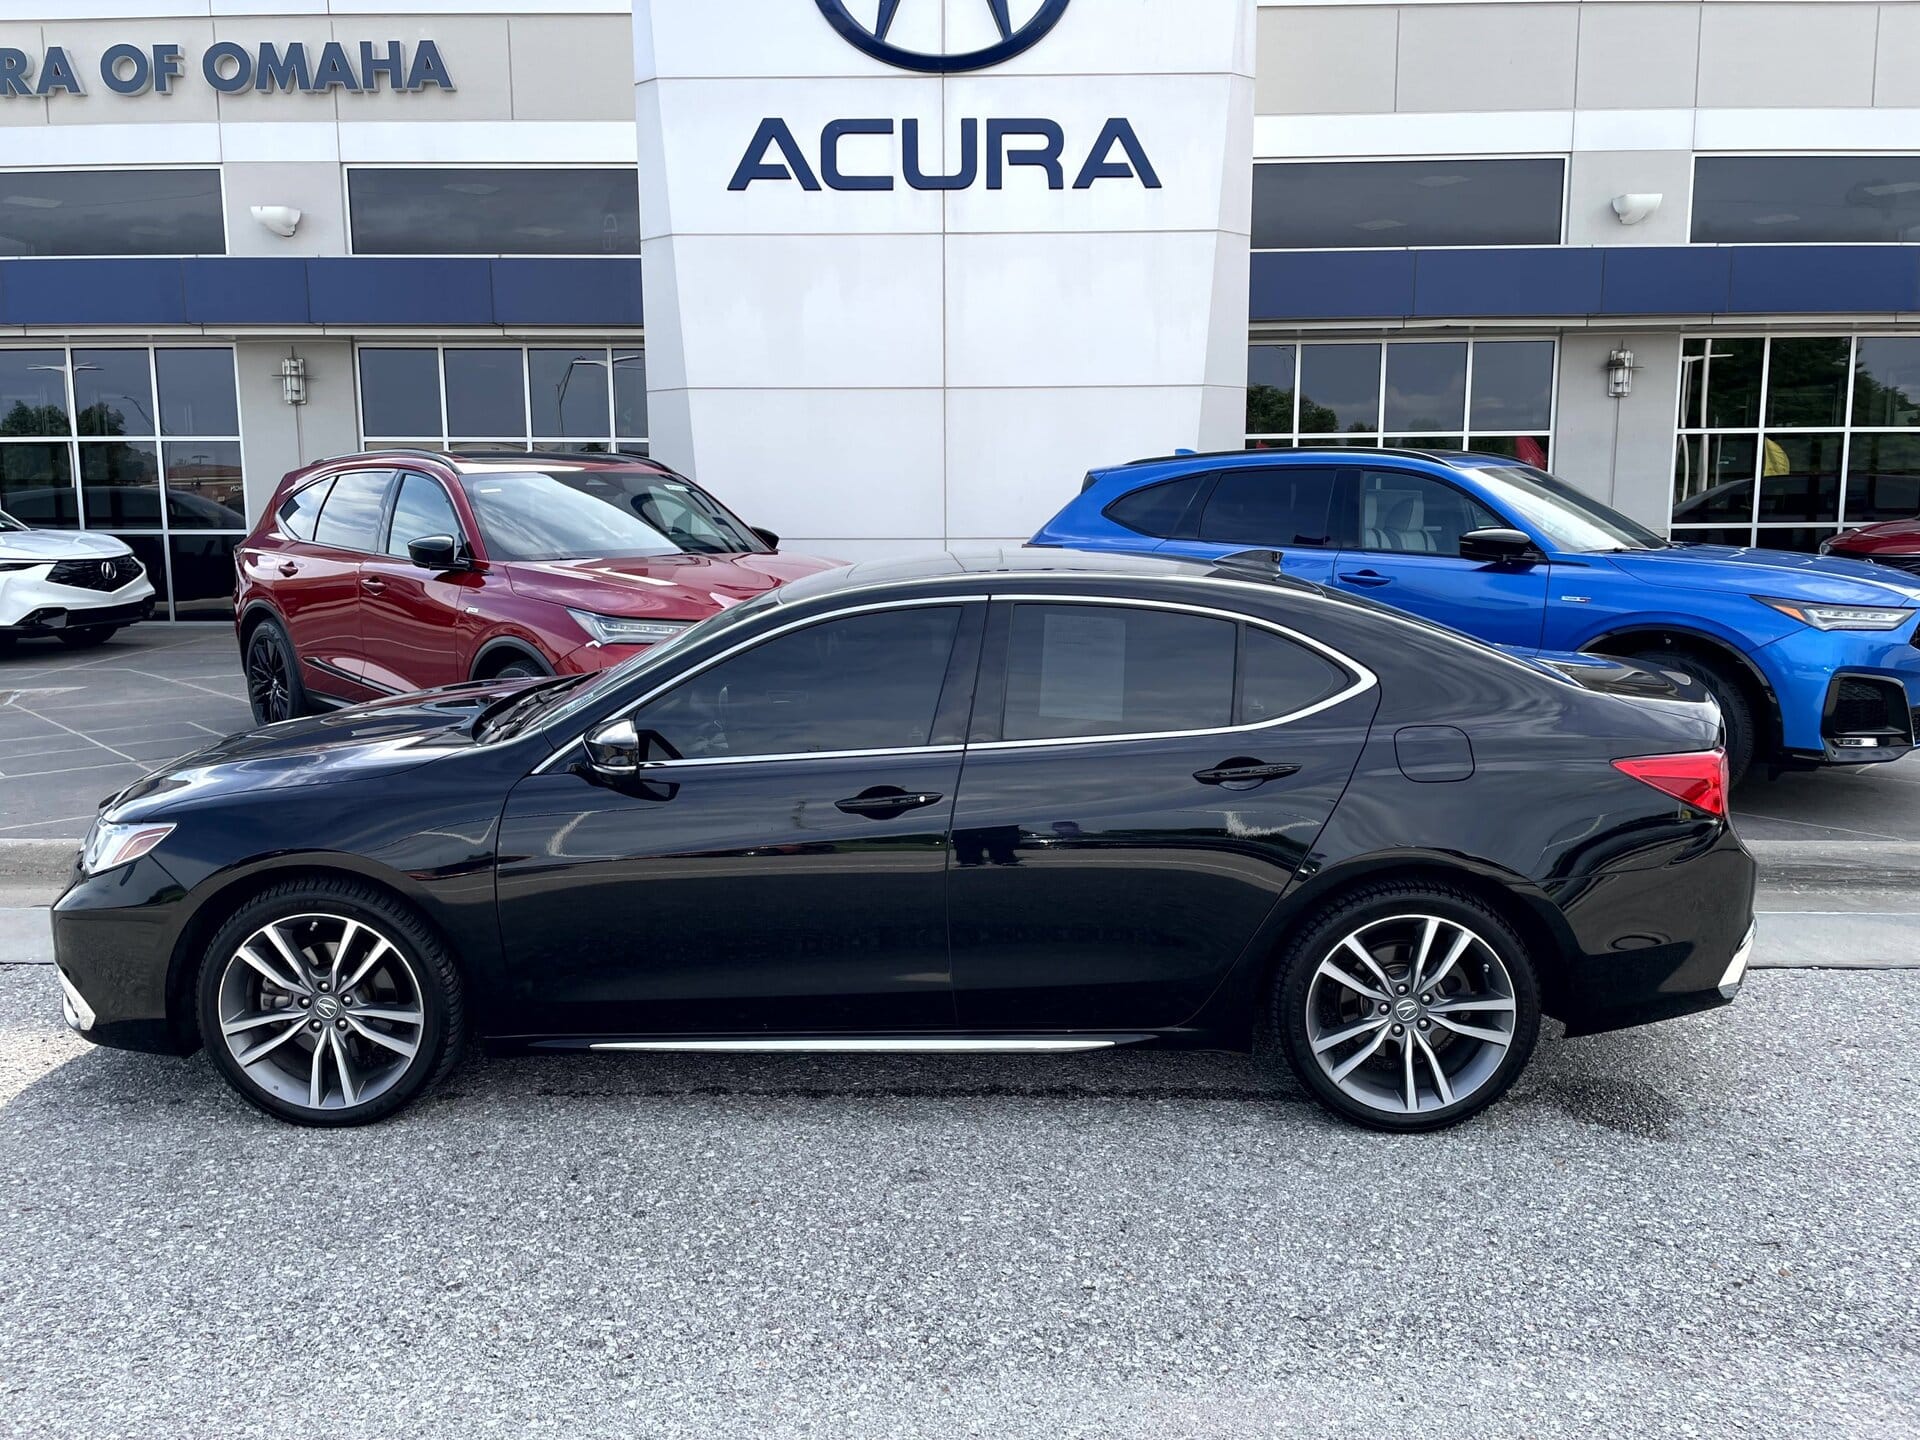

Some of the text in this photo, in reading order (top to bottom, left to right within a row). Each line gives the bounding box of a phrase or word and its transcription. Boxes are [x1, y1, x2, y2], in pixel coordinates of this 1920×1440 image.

[0, 40, 456, 96] RA OF OMAHA
[727, 117, 1162, 191] ACURA
